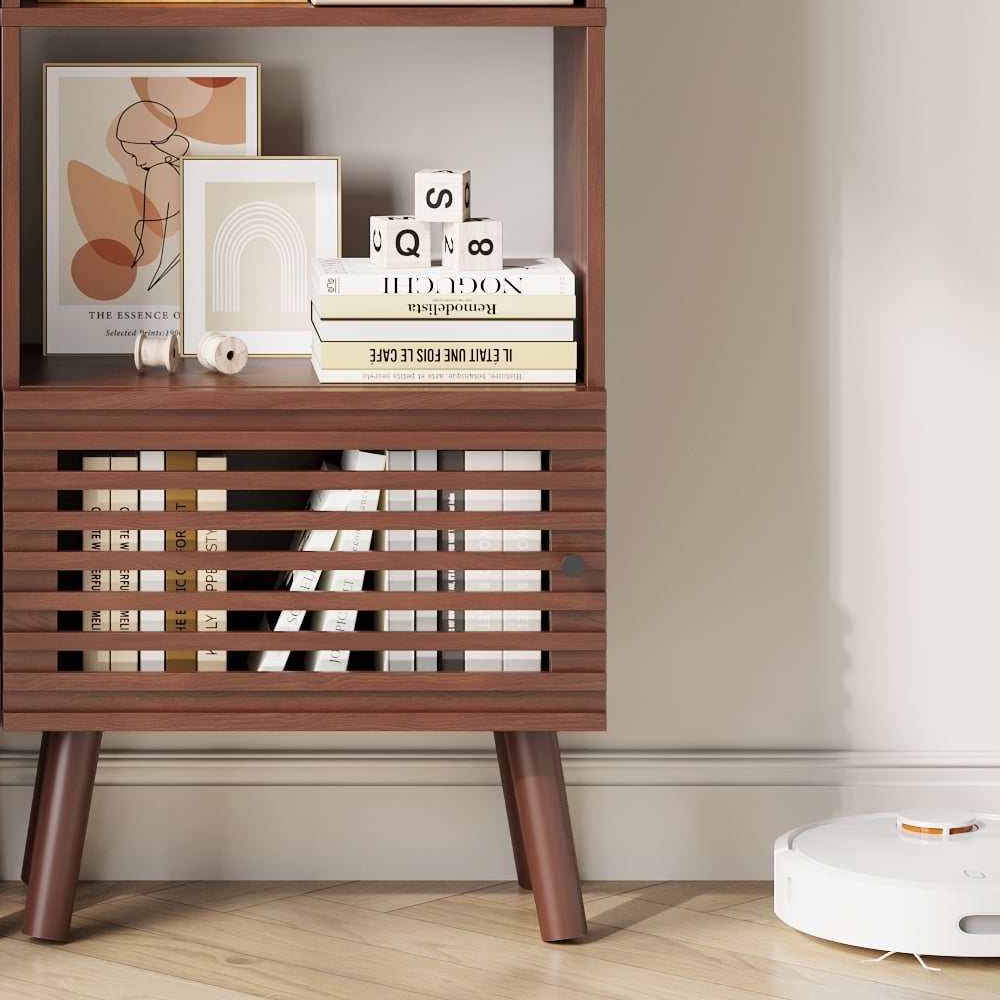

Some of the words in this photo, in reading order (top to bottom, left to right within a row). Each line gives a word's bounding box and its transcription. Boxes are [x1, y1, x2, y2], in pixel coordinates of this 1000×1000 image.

[426, 187, 453, 209] S
[395, 229, 420, 258] Q
[468, 238, 494, 256] 8
[384, 276, 522, 294] NOGUCHI
[89, 311, 113, 320] THE
[117, 311, 169, 320] ESSENCE
[173, 311, 181, 320] O
[408, 303, 497, 315] Remodelista
[105, 329, 137, 337] Selected
[369, 348, 398, 365] CAFÉ
[401, 348, 414, 362] LE
[416, 348, 441, 362] FOIS
[444, 348, 466, 362] UNE
[469, 348, 500, 365] ÉTAIT
[503, 348, 513, 362] IL
